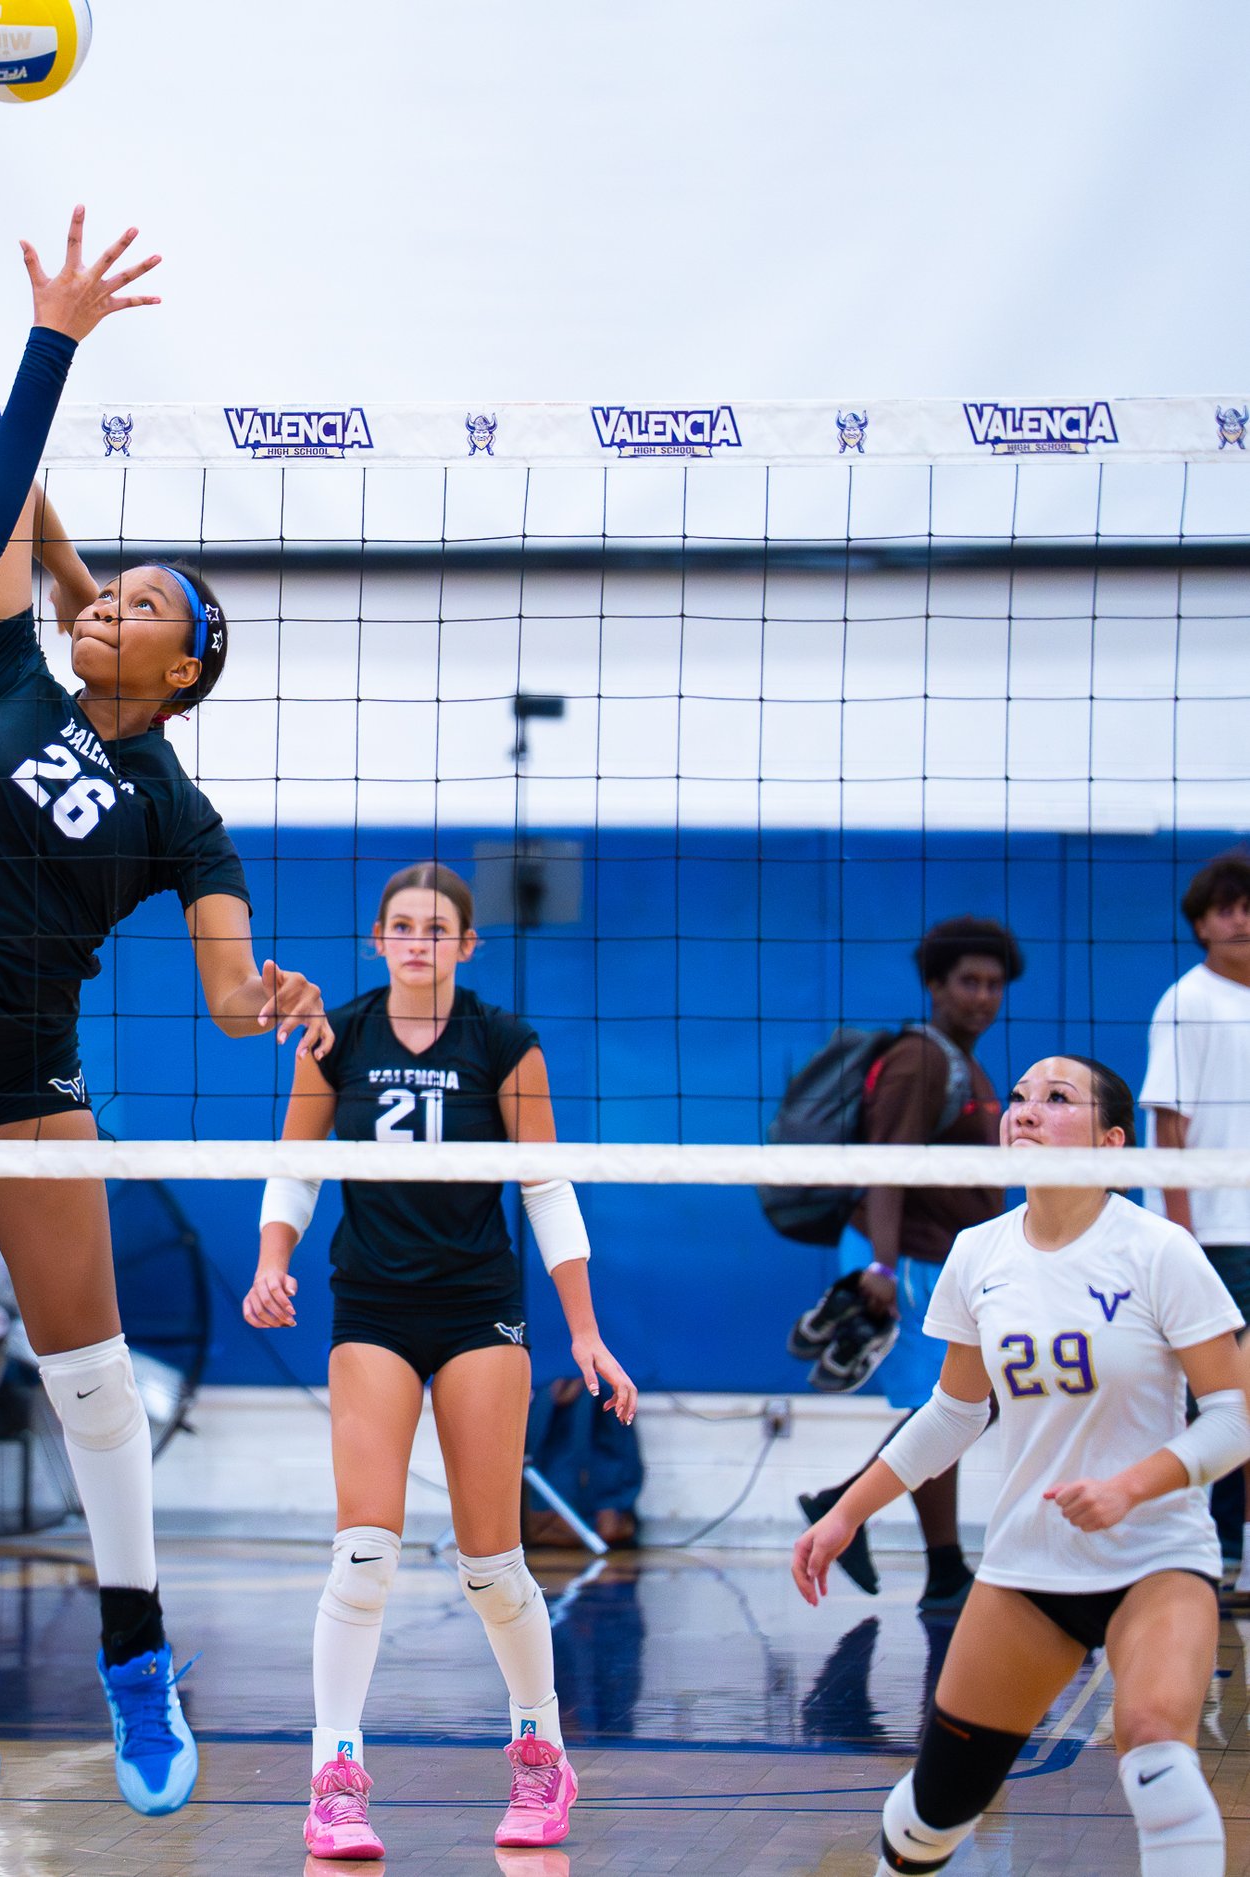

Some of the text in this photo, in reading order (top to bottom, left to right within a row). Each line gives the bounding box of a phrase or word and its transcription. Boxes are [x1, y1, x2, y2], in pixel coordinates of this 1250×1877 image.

[223, 407, 374, 448] VALENCIA
[591, 405, 742, 447] VALENCIA
[962, 402, 1119, 444] VALENCIA
[268, 447, 330, 456] HIGH SCHOOL
[633, 446, 696, 455] HIGH SCHOOL
[1007, 443, 1072, 451] HIGH SCHOOL
[10, 743, 117, 840] 26
[375, 1088, 444, 1143] 21
[997, 1329, 1099, 1399] 29
